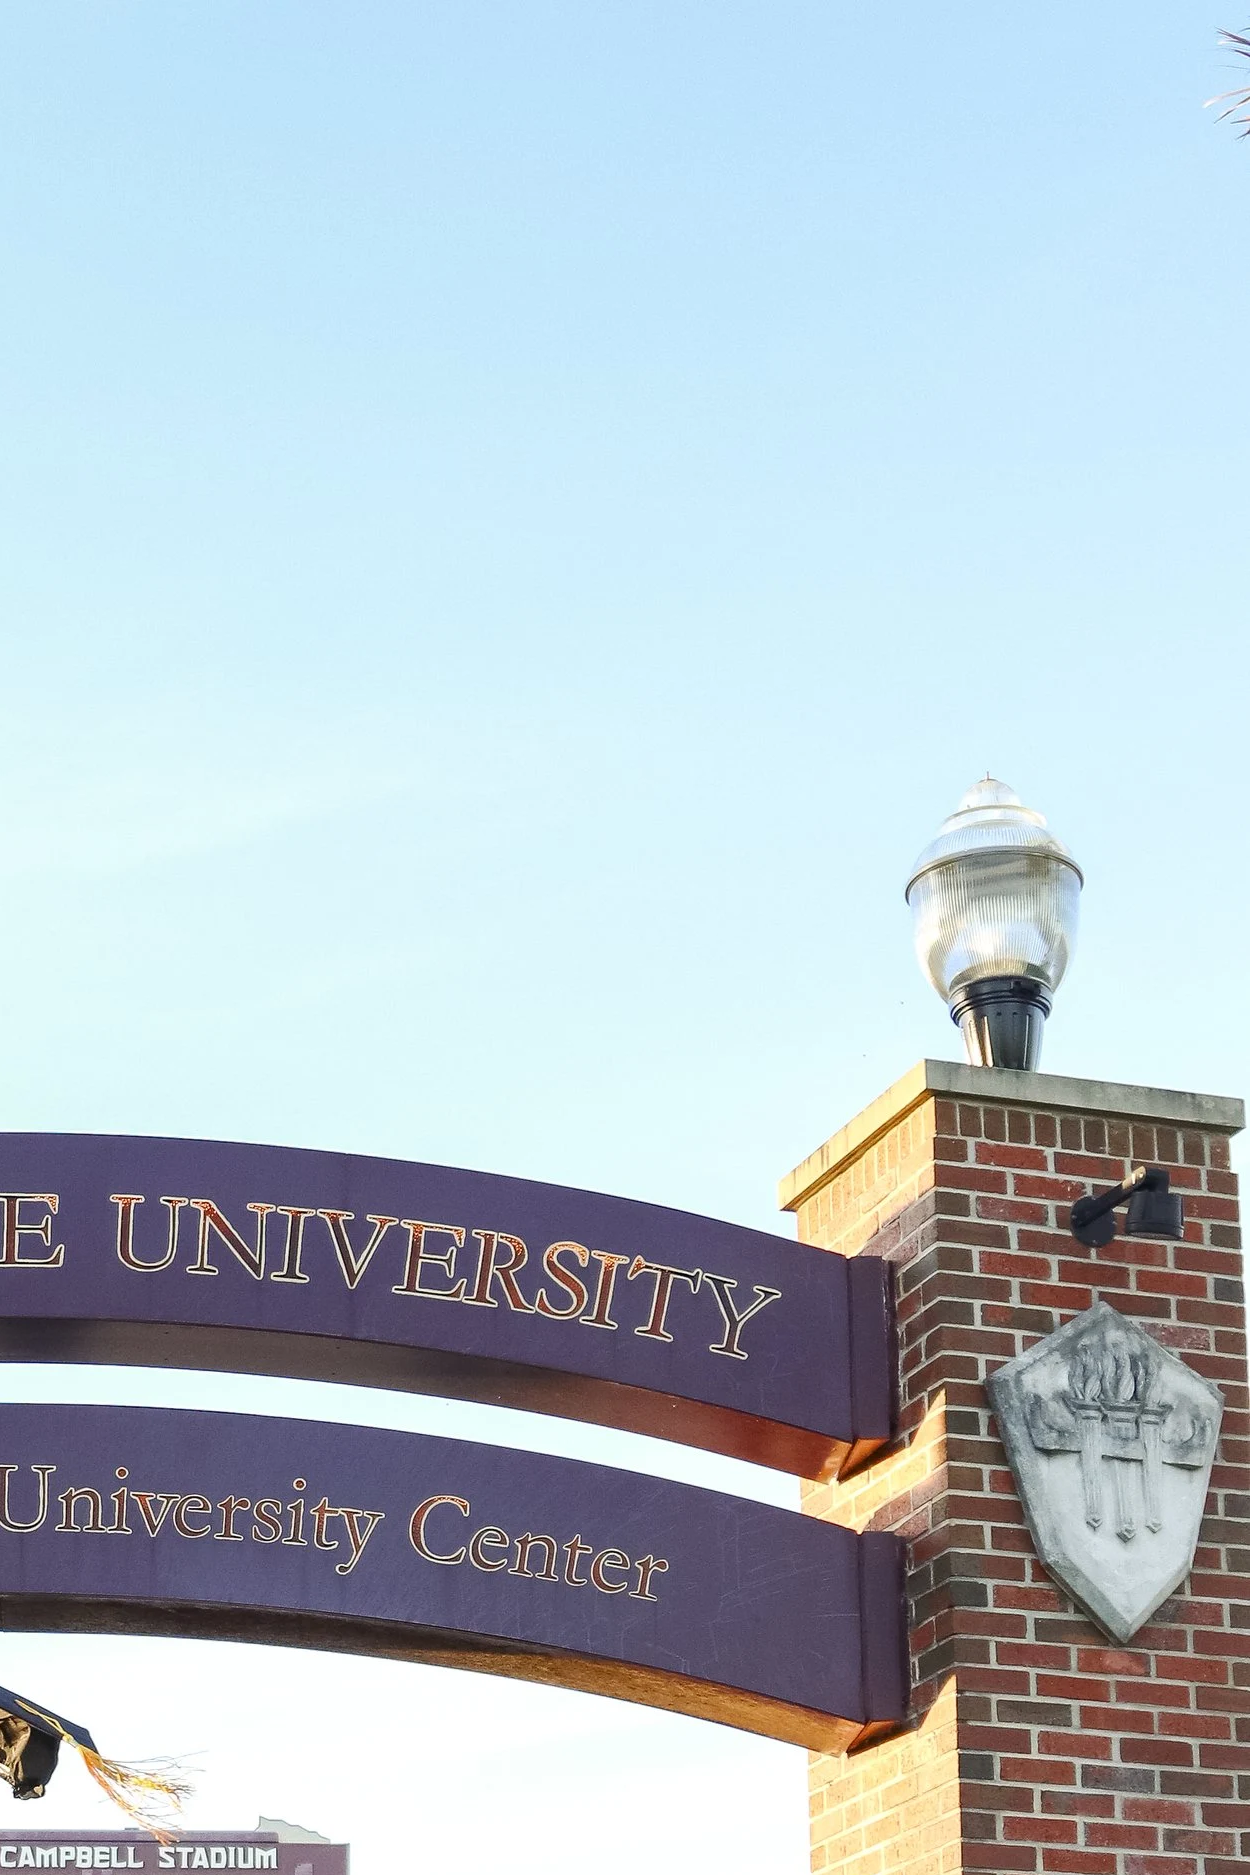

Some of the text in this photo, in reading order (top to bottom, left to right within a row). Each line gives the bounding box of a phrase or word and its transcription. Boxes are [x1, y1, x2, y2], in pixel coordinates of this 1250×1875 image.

[110, 1194, 783, 1361] UNIVERSITY
[408, 1494, 670, 1602] Center
[0, 1846, 144, 1869] CAMPBELL
[158, 1846, 278, 1869] STADIUM
